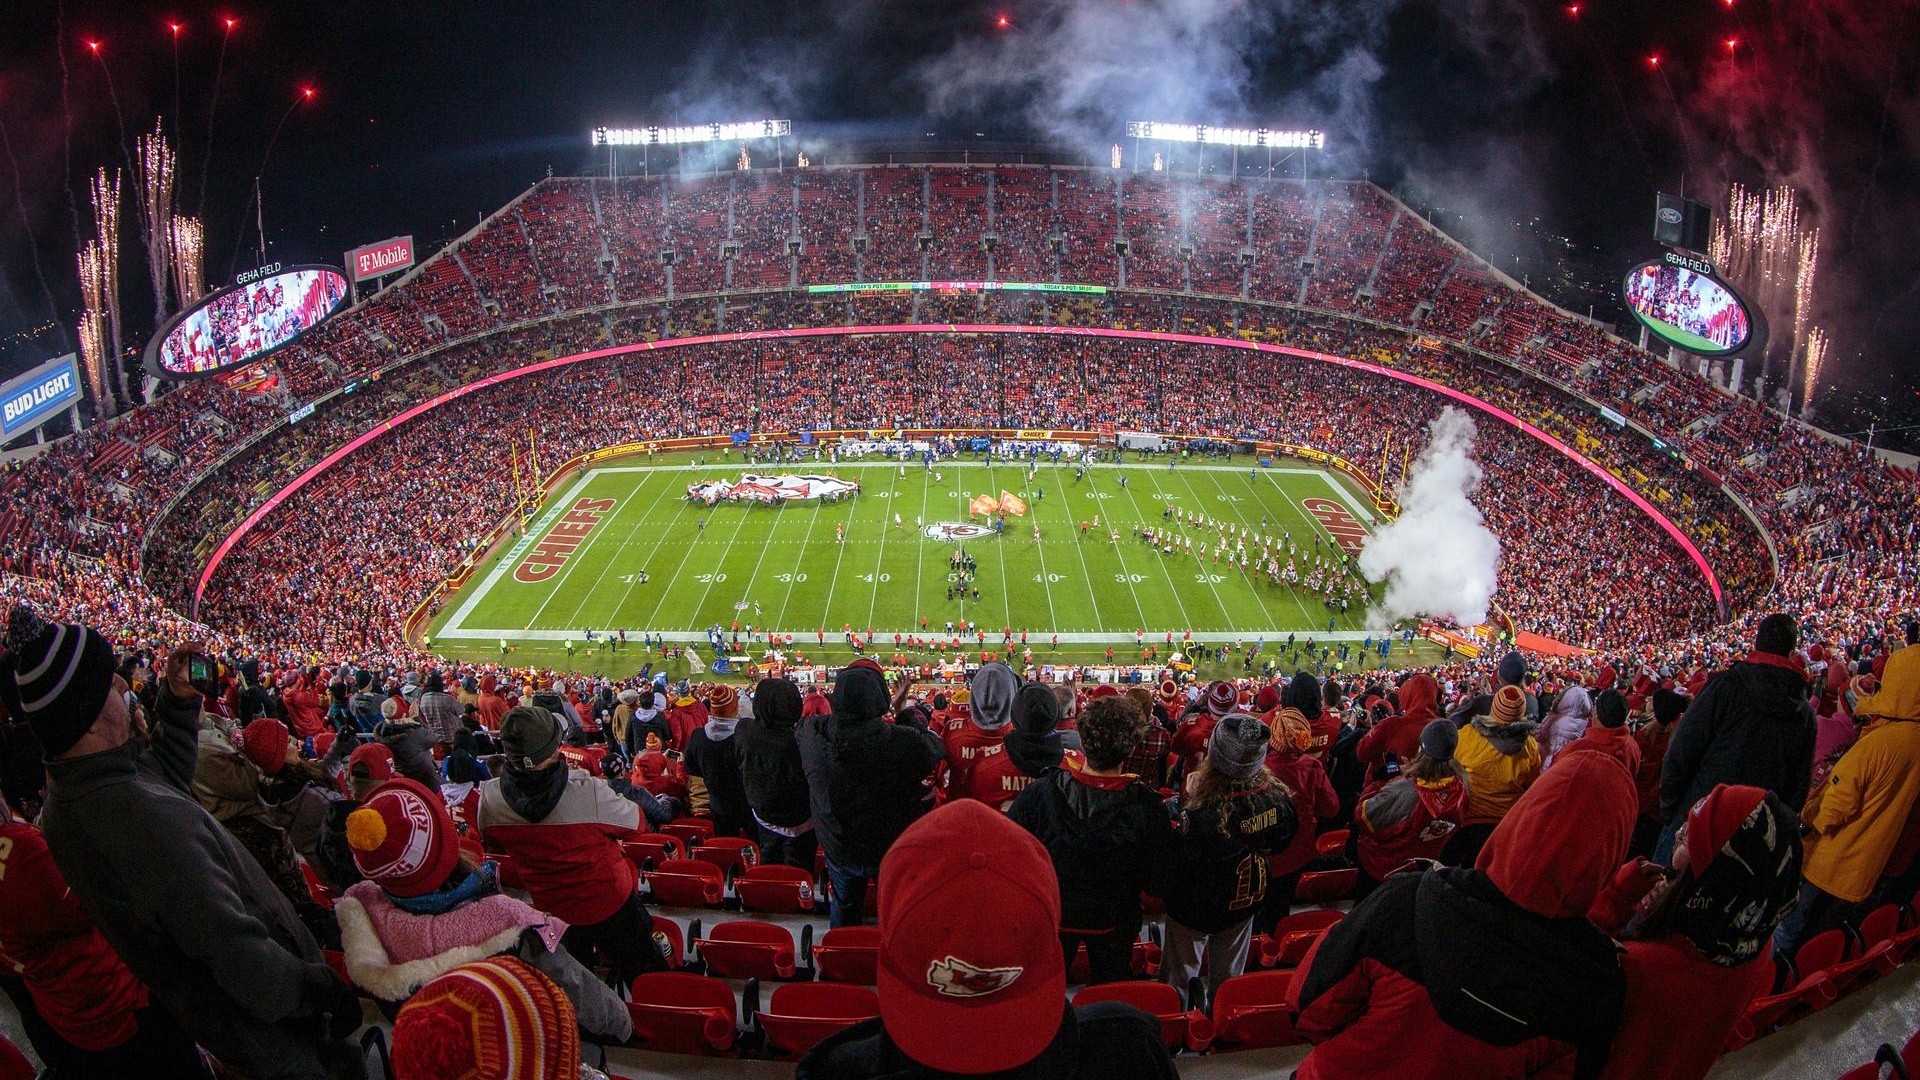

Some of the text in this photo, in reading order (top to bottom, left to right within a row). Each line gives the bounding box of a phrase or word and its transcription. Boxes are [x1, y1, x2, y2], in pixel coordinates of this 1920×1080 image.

[1666, 252, 1711, 274] GEHA FIELD
[236, 262, 281, 285] GEHA FIELD
[3, 372, 72, 422] BUD LIGHT
[513, 498, 617, 583] CHIEFS
[699, 573, 727, 583] 20
[779, 573, 807, 583] 30
[863, 573, 891, 583] 40
[1032, 573, 1060, 583] 40
[1115, 573, 1142, 583] 30
[1194, 573, 1222, 583] 20
[1240, 807, 1277, 835] SMITH
